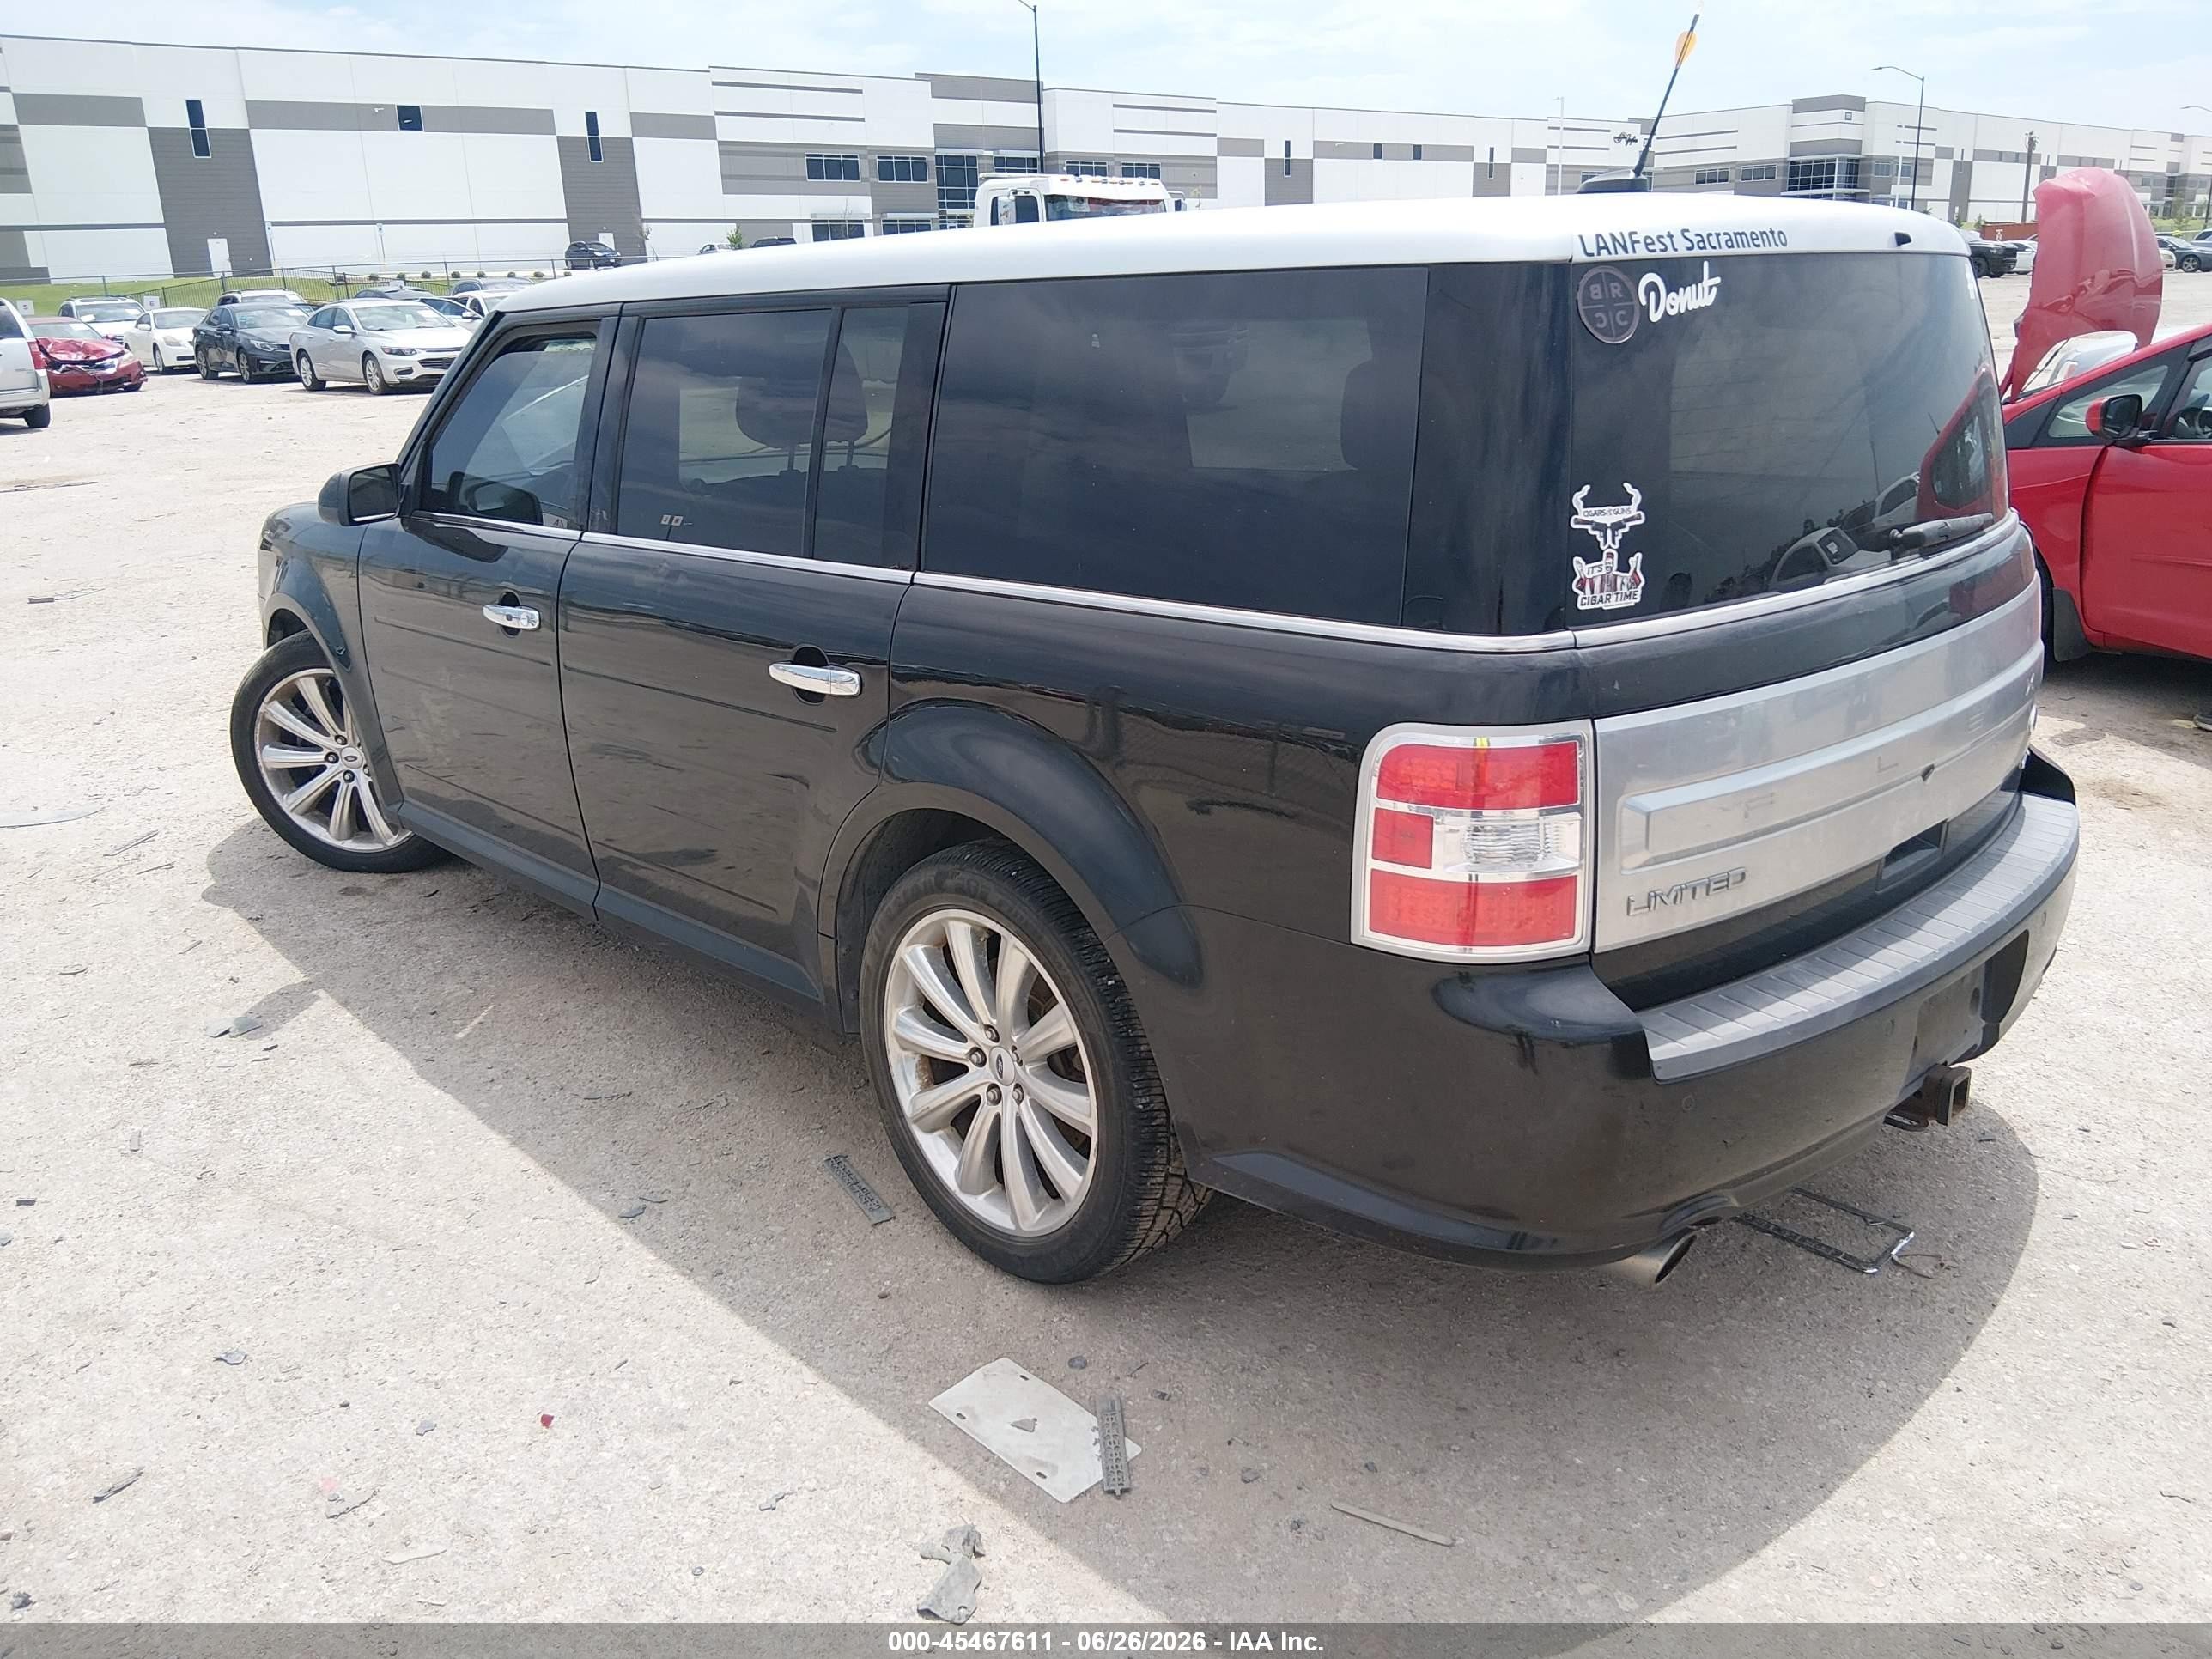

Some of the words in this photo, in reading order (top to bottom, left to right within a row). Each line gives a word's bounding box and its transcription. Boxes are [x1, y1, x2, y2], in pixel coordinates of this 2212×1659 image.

[1578, 230, 1678, 257] LANFest
[1680, 227, 1789, 252] Sacramento
[1638, 260, 1722, 323] Donut
[1581, 592, 1612, 606] CIGAR
[1614, 590, 1638, 602] TIME
[1626, 866, 1747, 916] LIMITED
